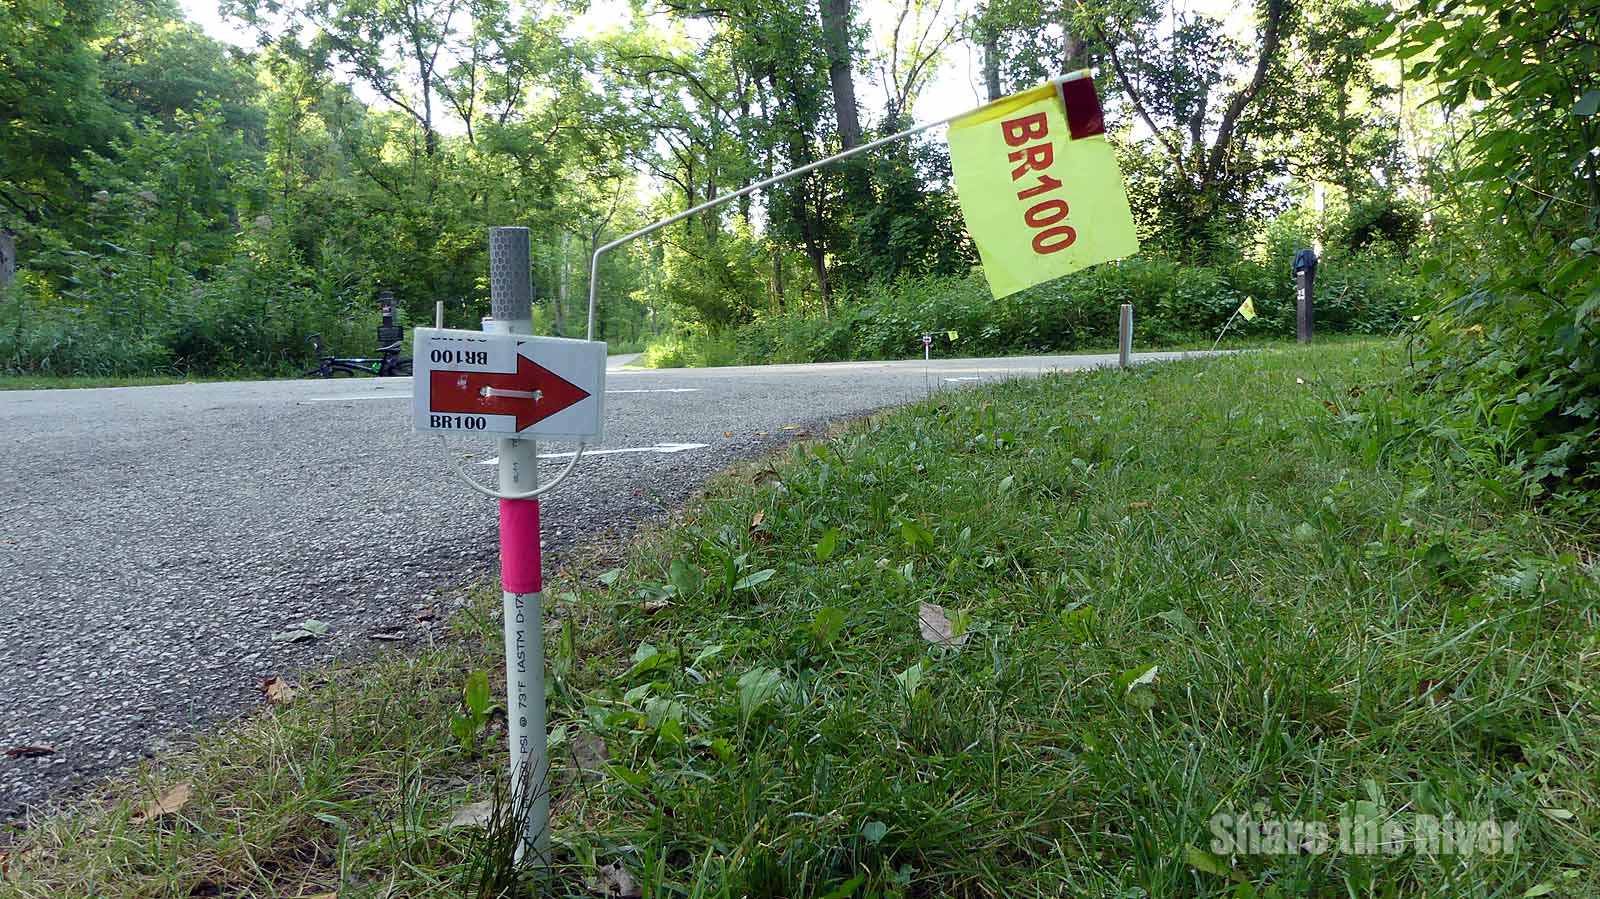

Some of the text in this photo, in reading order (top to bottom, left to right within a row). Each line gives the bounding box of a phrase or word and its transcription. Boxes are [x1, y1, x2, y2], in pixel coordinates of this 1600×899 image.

[1001, 112, 1077, 254] BR100
[430, 350, 488, 365] BR100
[430, 415, 487, 430] BR100
[519, 717, 528, 727] @
[520, 735, 528, 754] PSI
